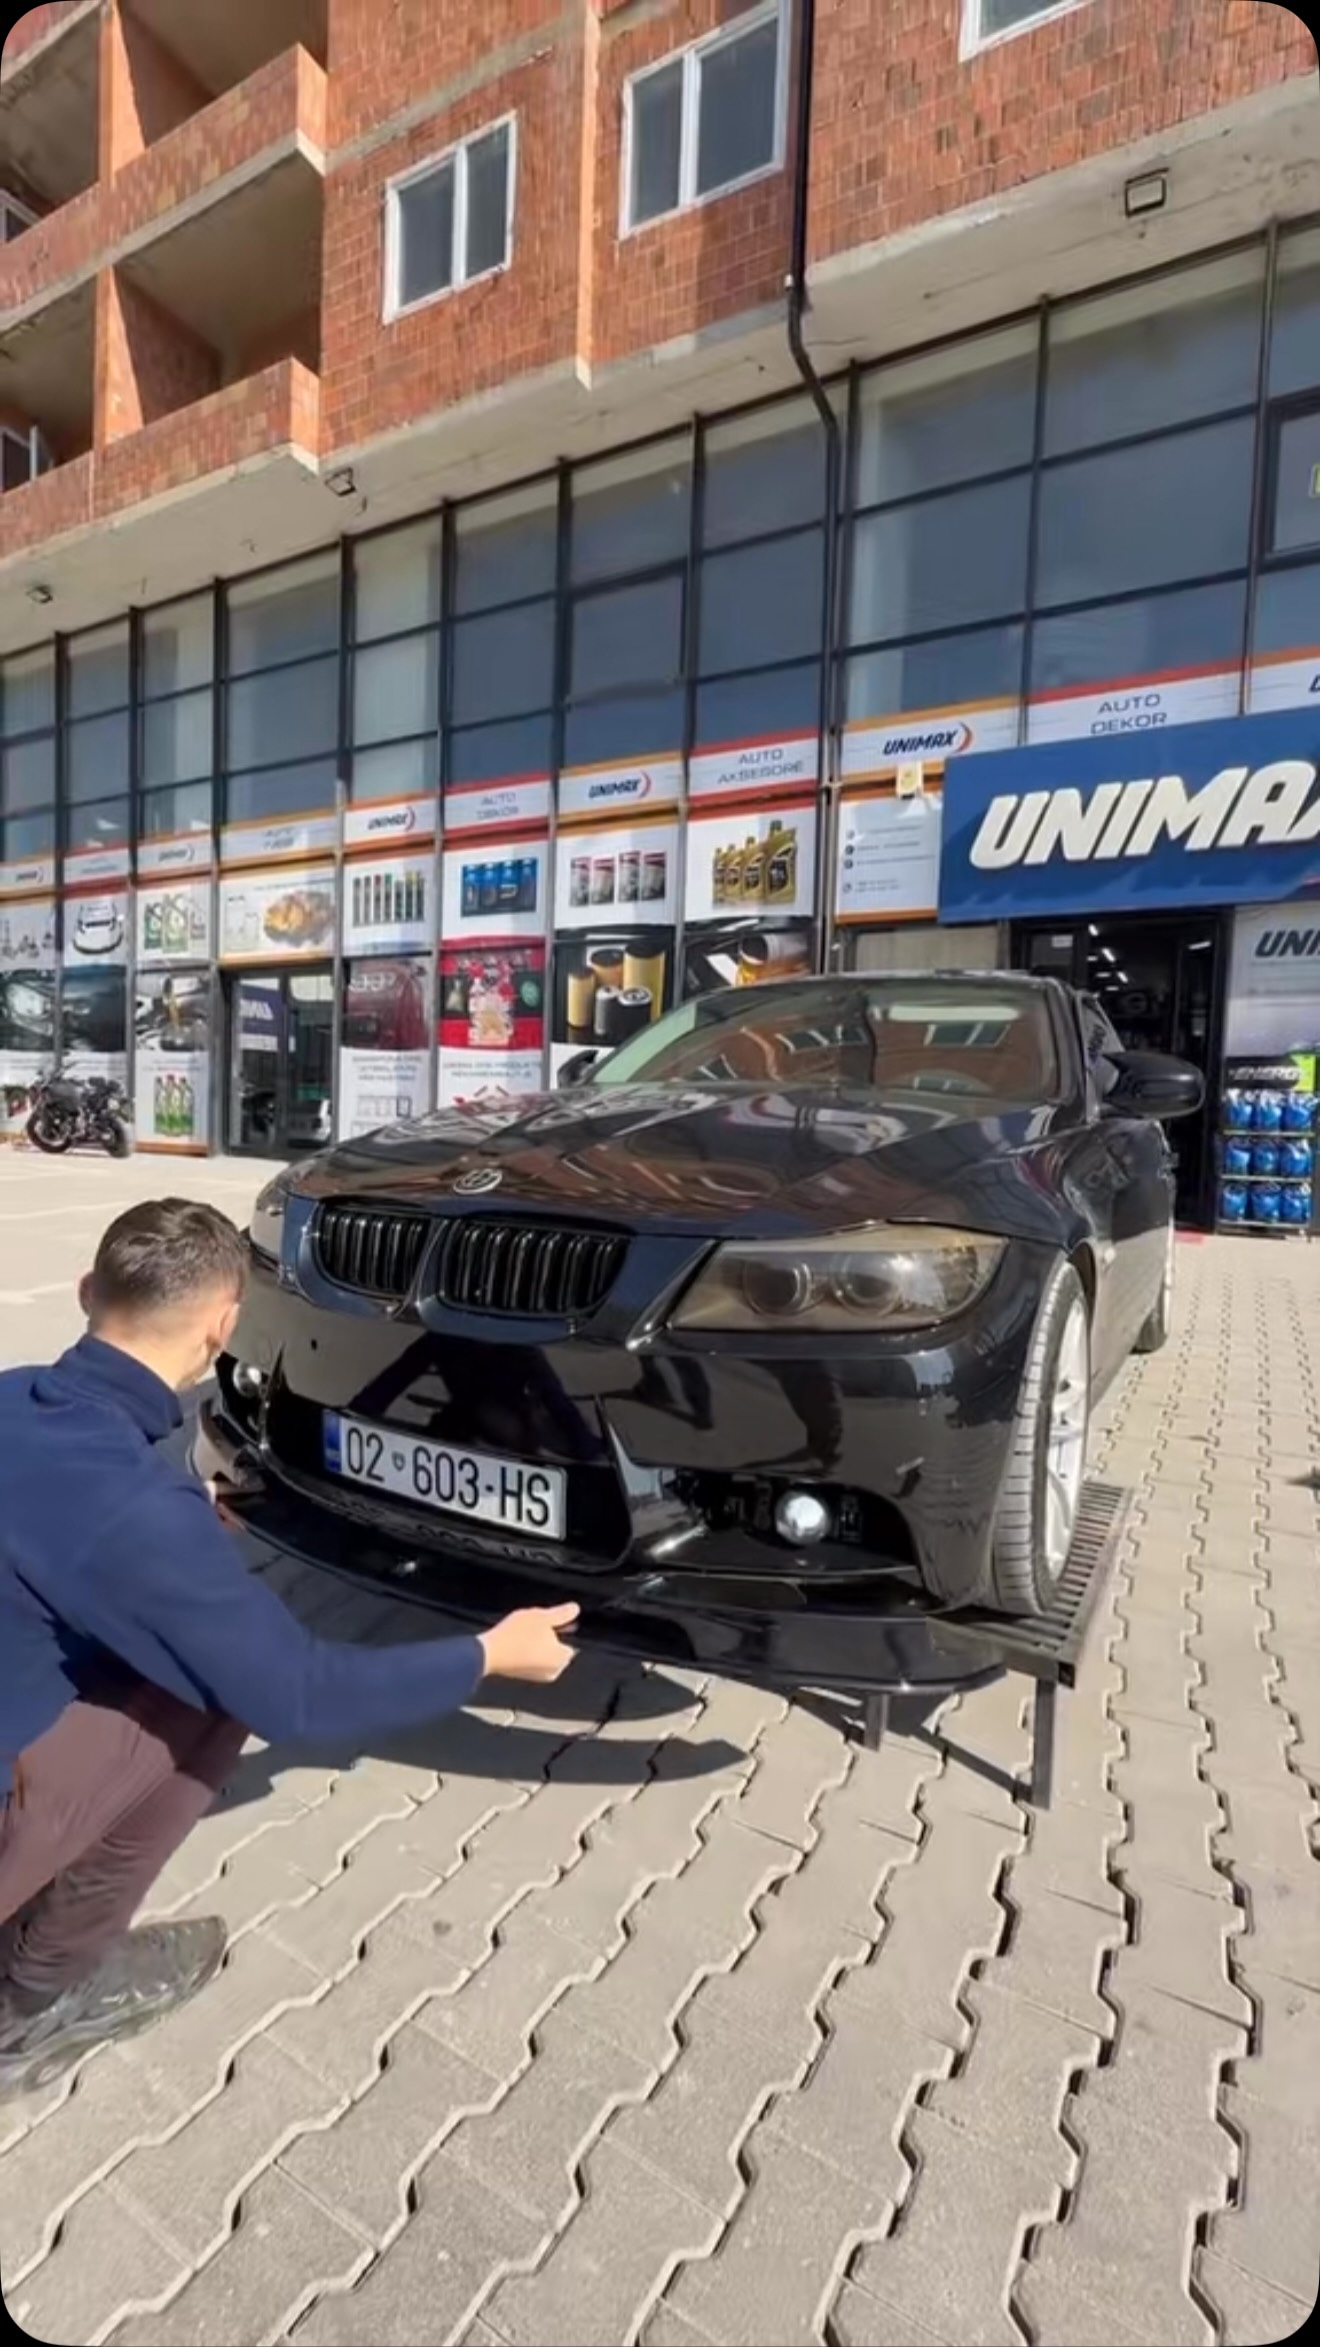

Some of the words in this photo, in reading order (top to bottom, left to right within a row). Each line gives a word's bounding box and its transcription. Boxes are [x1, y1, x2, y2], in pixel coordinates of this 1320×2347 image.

[1097, 694, 1161, 714] AUTO
[1090, 712, 1167, 735] DEKOR
[883, 729, 959, 755] UNIMAX
[738, 749, 783, 765] AUTO
[588, 778, 641, 799] UNIMAX
[346, 1427, 384, 1482] 02
